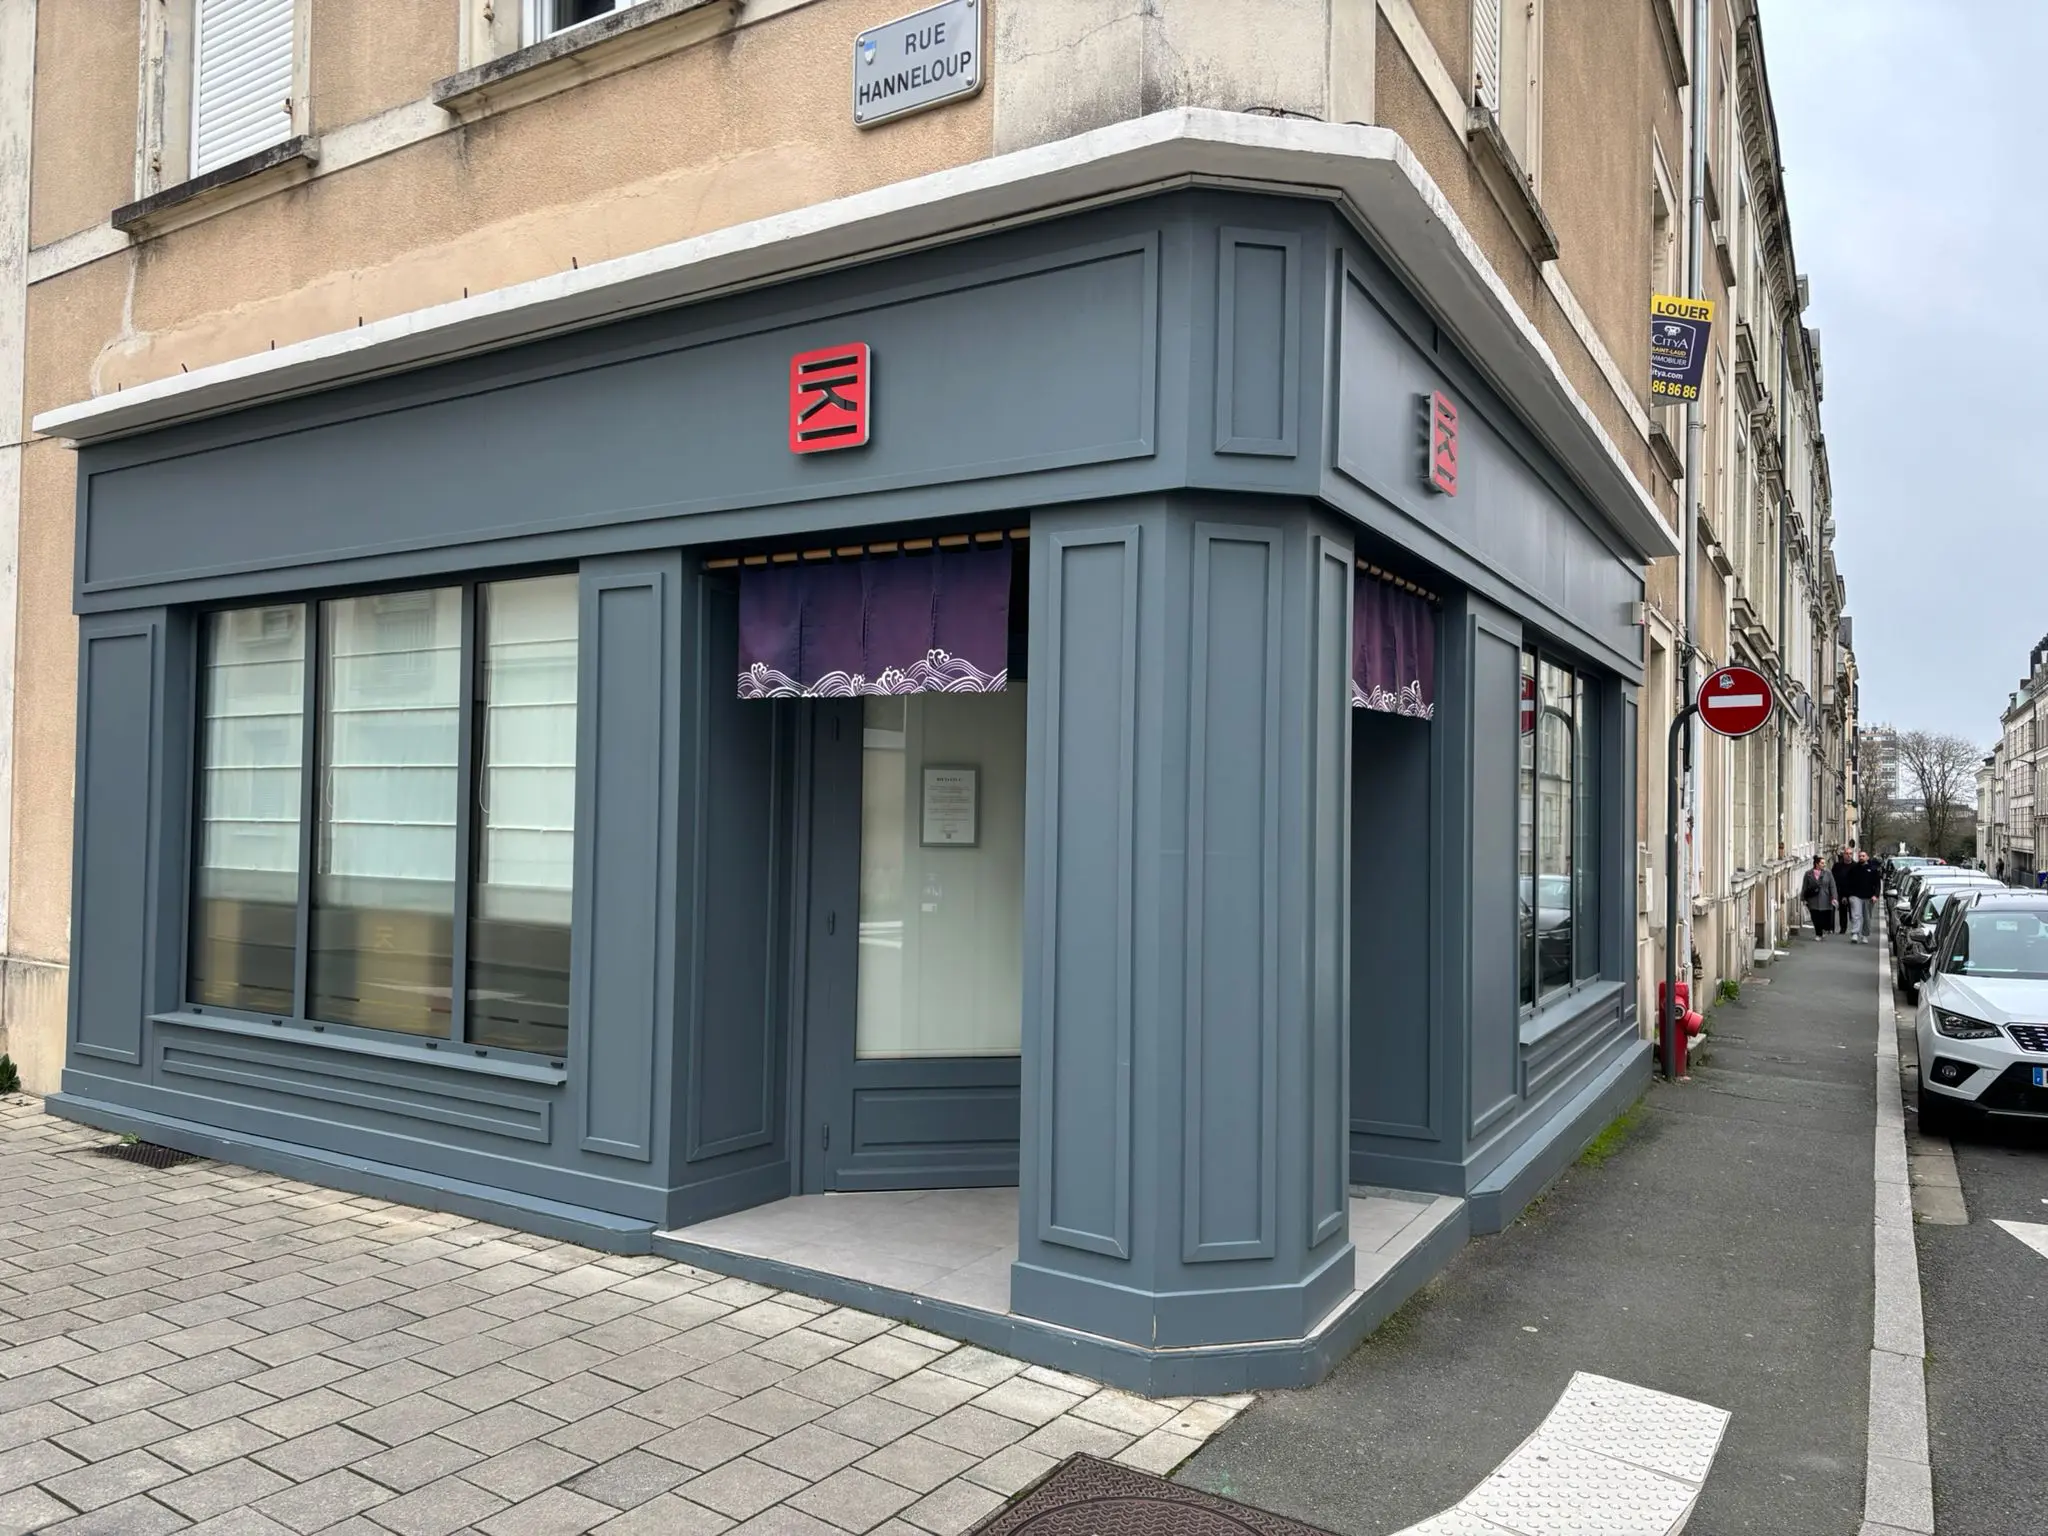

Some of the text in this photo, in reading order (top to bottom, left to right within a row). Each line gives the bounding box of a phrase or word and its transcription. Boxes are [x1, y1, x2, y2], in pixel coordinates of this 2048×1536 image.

[905, 22, 946, 55] RUE
[859, 51, 972, 105] HANNELOUP
[1657, 301, 1710, 320] LOUER
[1652, 355, 1687, 366] MMOBILIER
[1652, 367, 1684, 380] itya.com
[1652, 380, 1697, 398] 86 86 86
